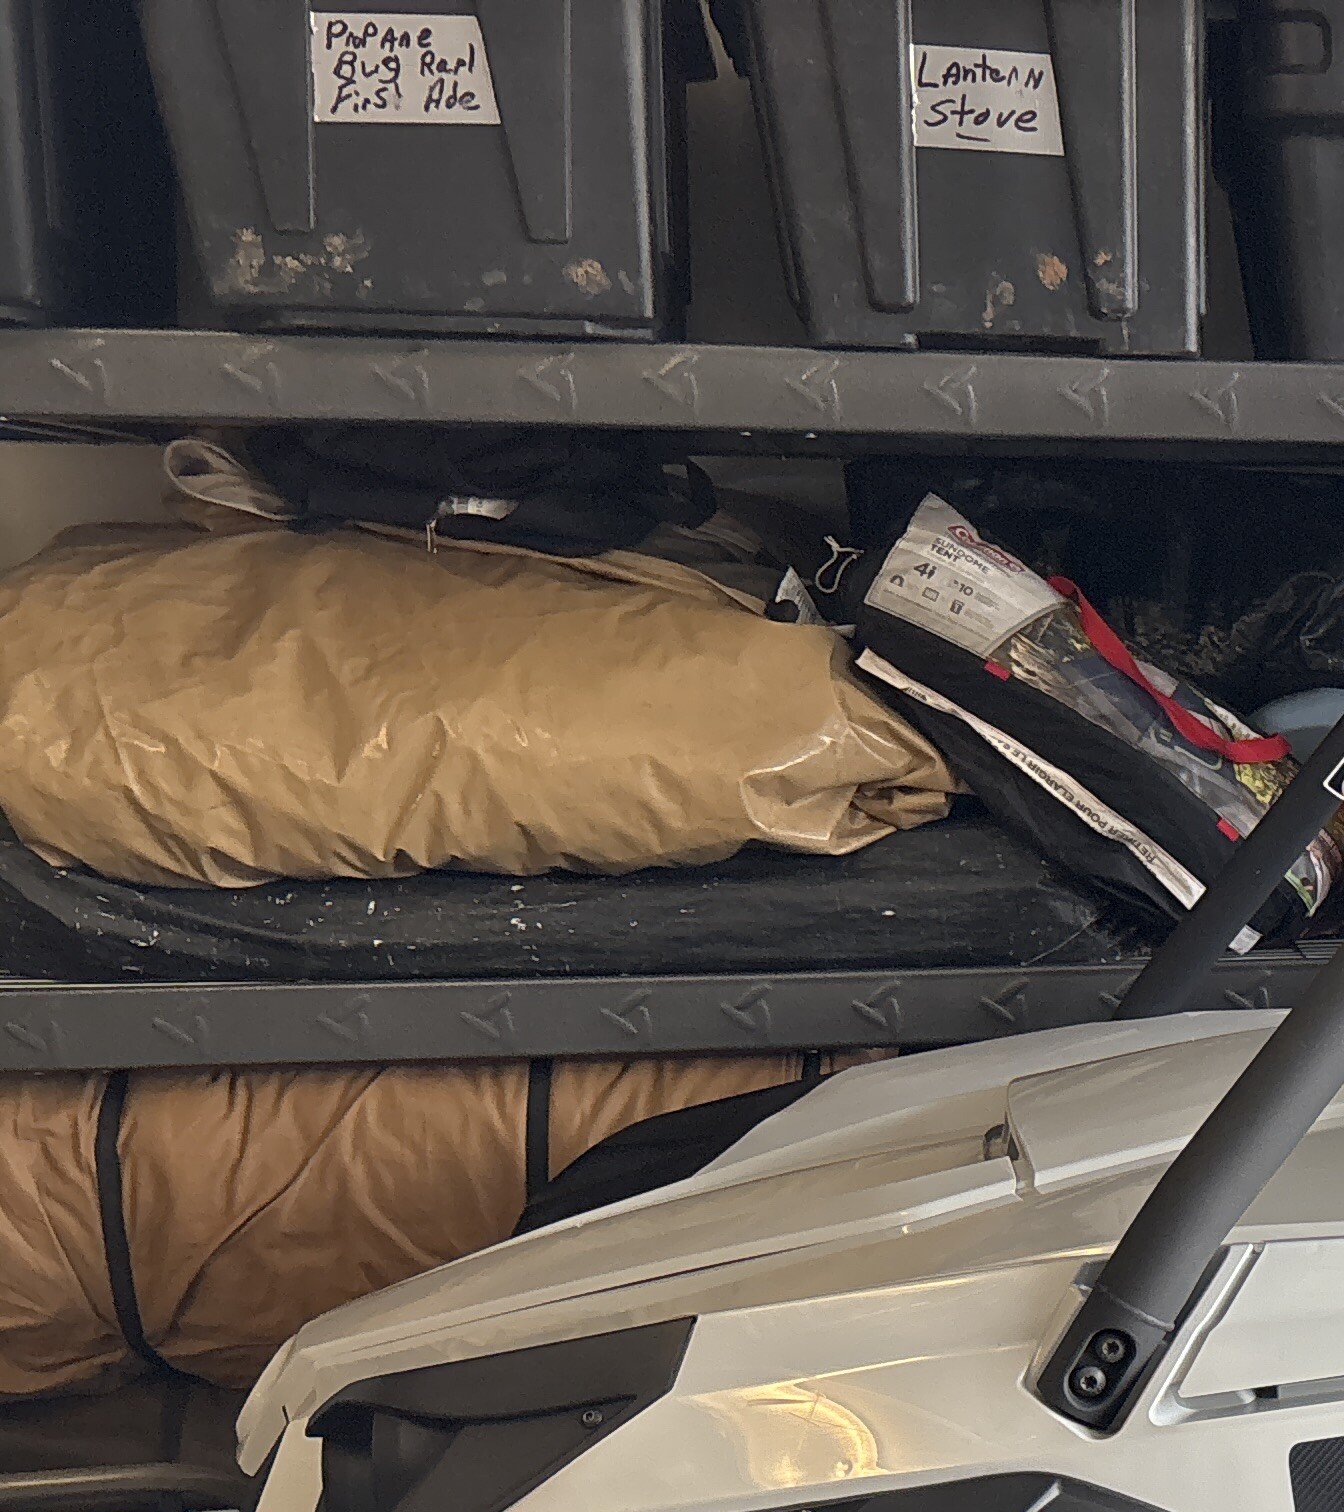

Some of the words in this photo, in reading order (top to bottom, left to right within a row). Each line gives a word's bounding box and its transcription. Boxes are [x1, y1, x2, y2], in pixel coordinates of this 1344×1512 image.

[332, 50, 401, 84] Bug
[923, 93, 1039, 133] Stove
[929, 543, 961, 563] TENT
[933, 537, 992, 575] SUNDOME
[1026, 758, 1076, 804] ELARGIR
[1075, 799, 1107, 828] POUR
